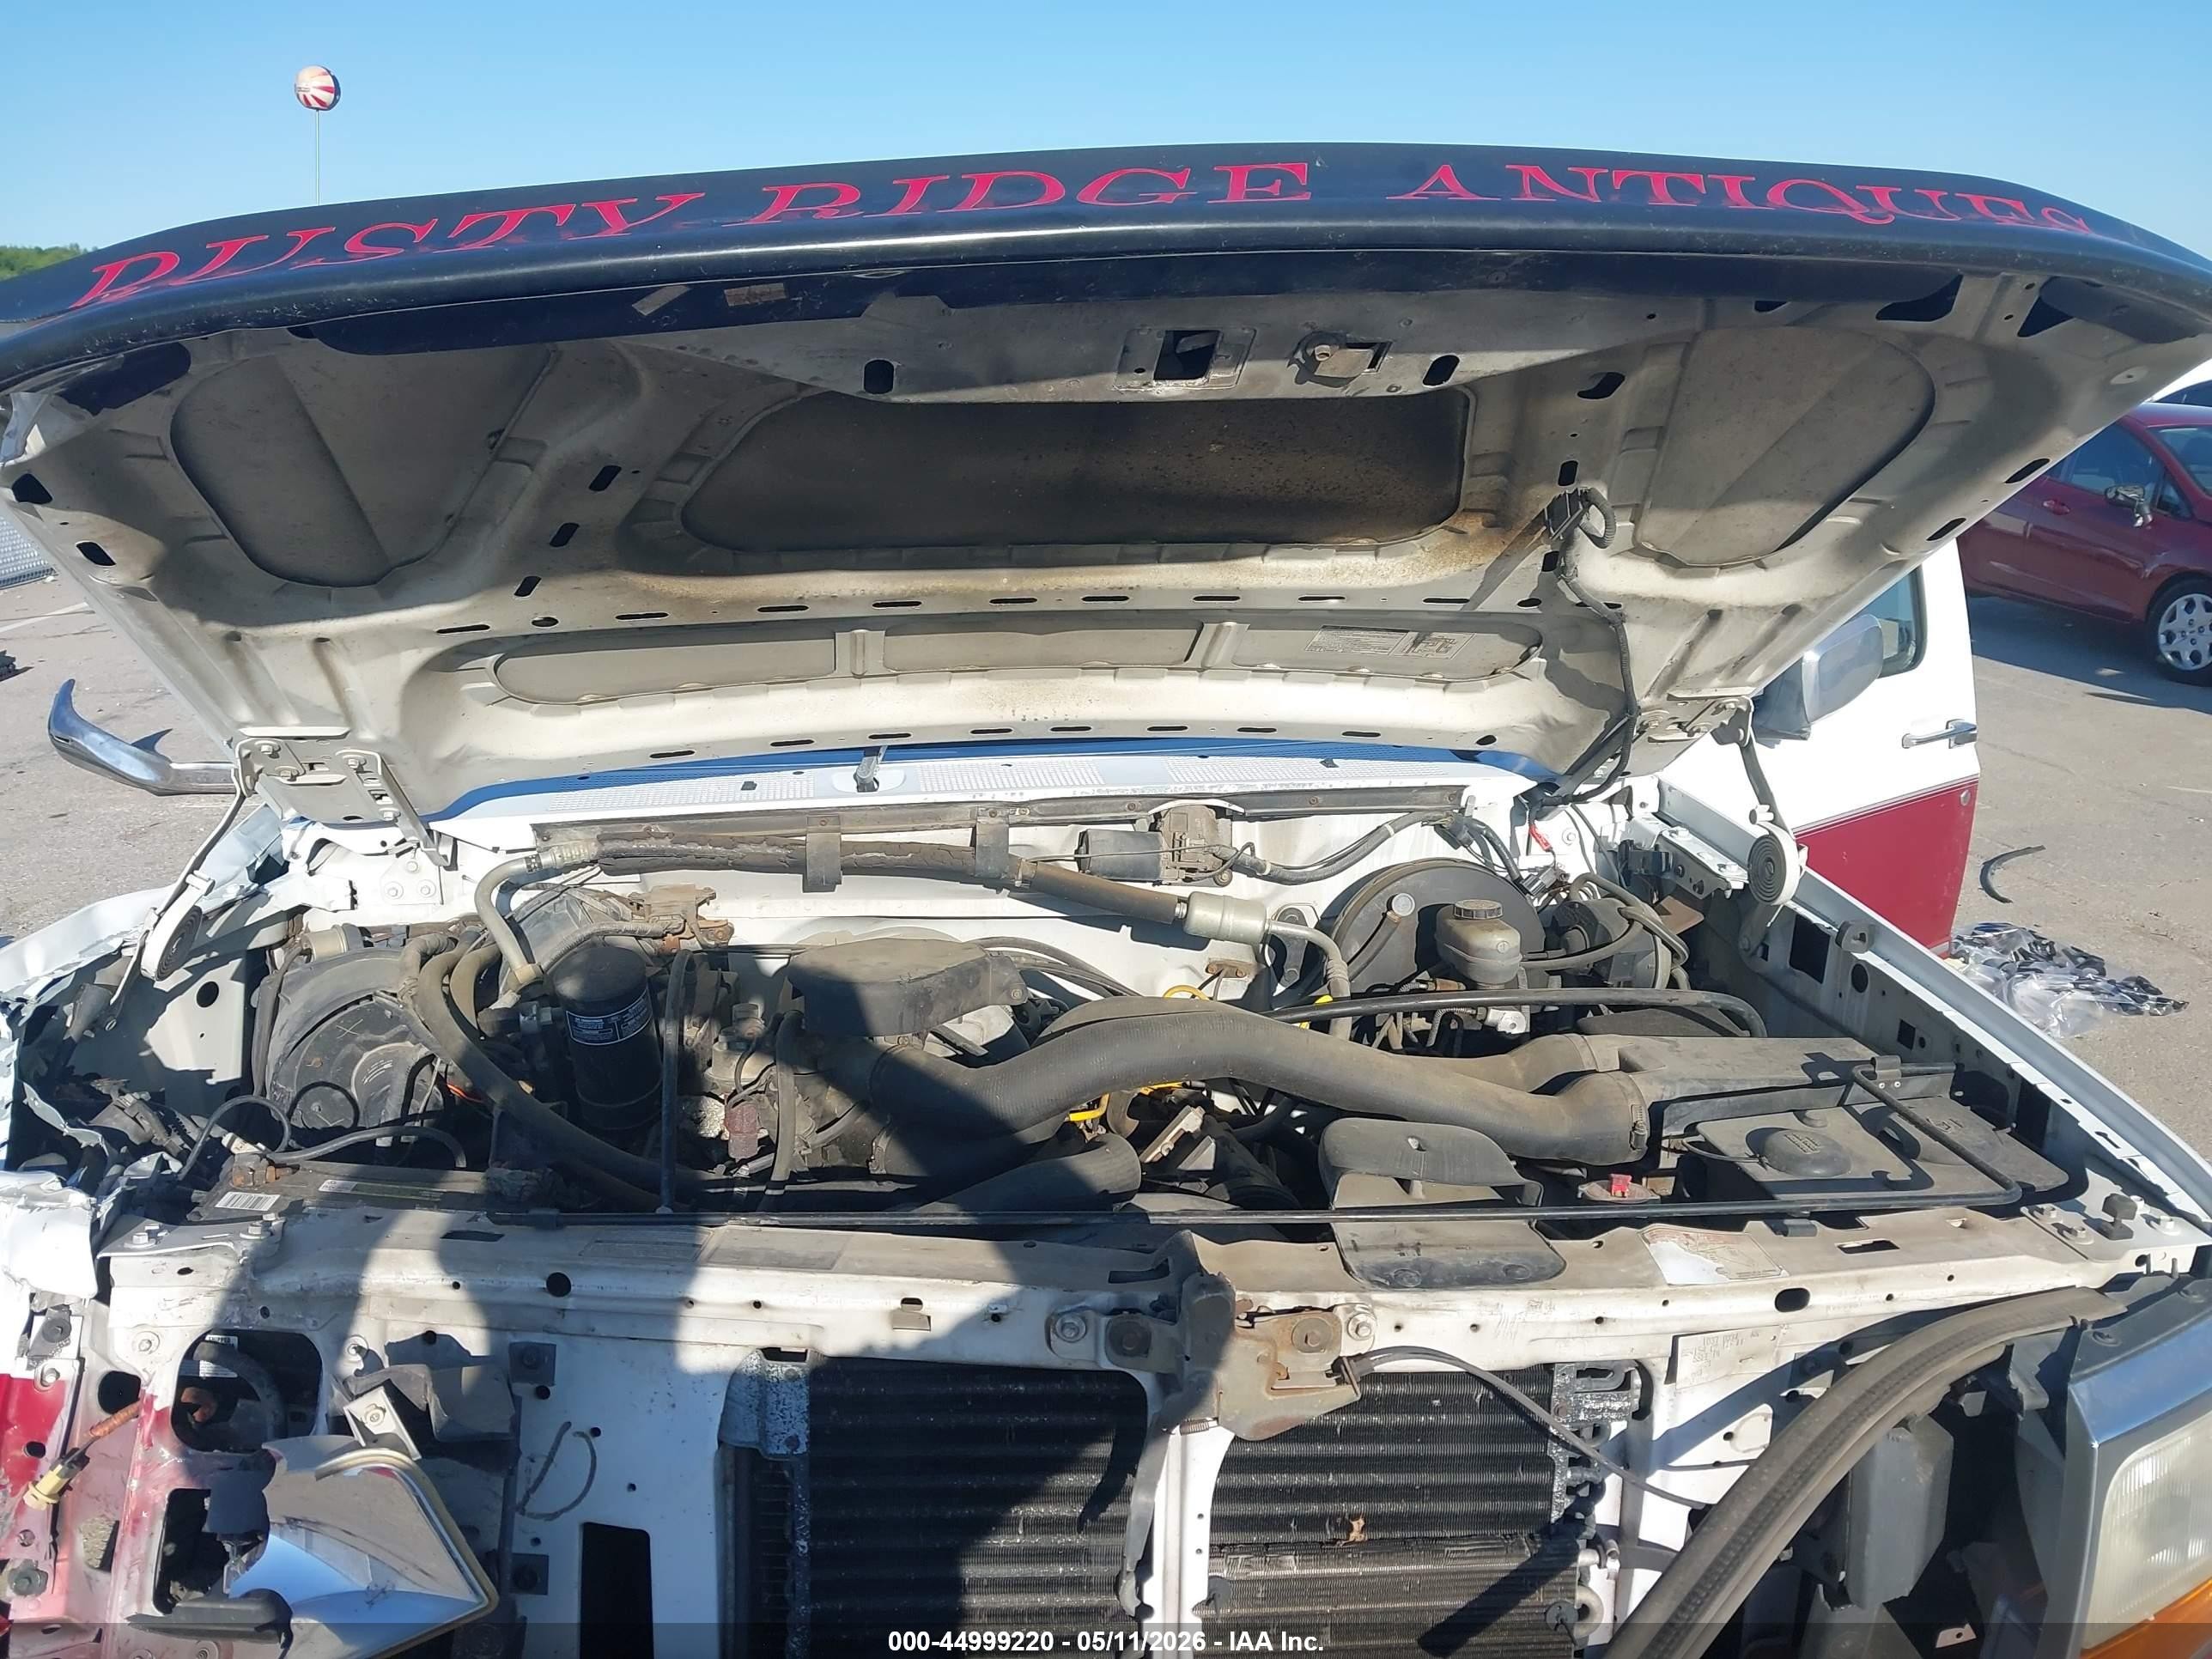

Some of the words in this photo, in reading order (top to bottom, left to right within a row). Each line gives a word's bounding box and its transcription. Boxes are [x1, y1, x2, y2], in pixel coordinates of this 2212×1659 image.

[69, 191, 706, 309] DUSTY
[721, 162, 1312, 227] RIDGE
[1386, 163, 2093, 234] ANTIQUES
